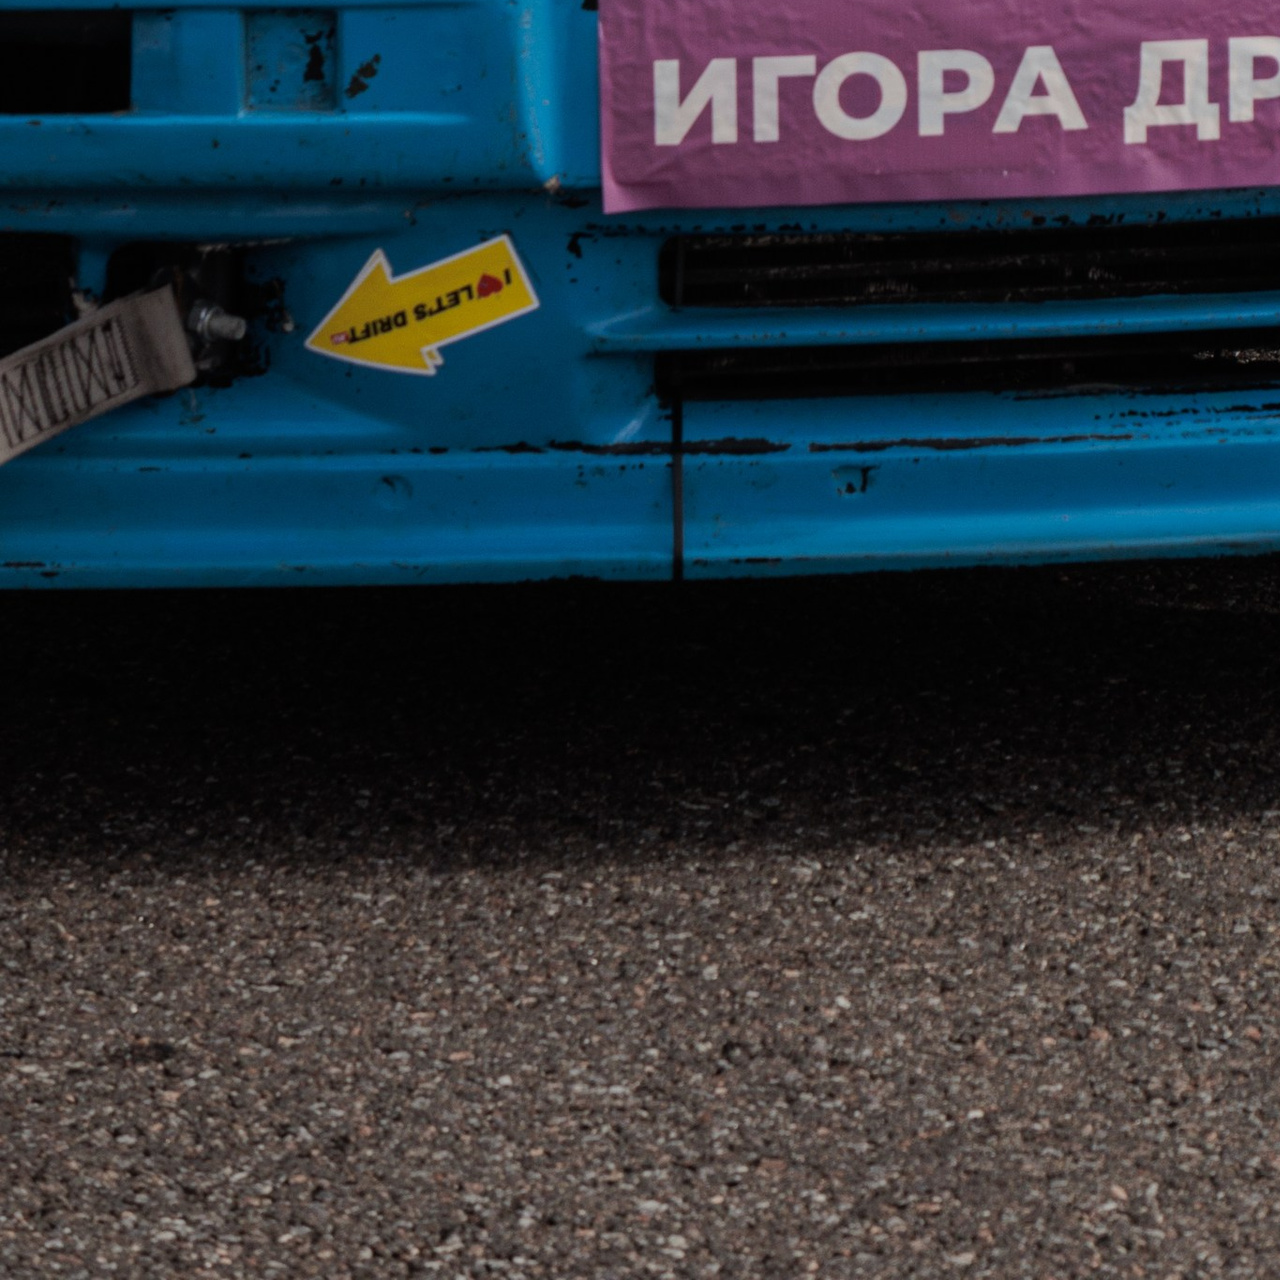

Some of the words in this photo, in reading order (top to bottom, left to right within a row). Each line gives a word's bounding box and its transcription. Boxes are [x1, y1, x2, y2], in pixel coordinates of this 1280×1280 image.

[652, 44, 1088, 147] ИГОРА
[413, 283, 475, 322] LET'S
[347, 309, 408, 344] DRIFT
